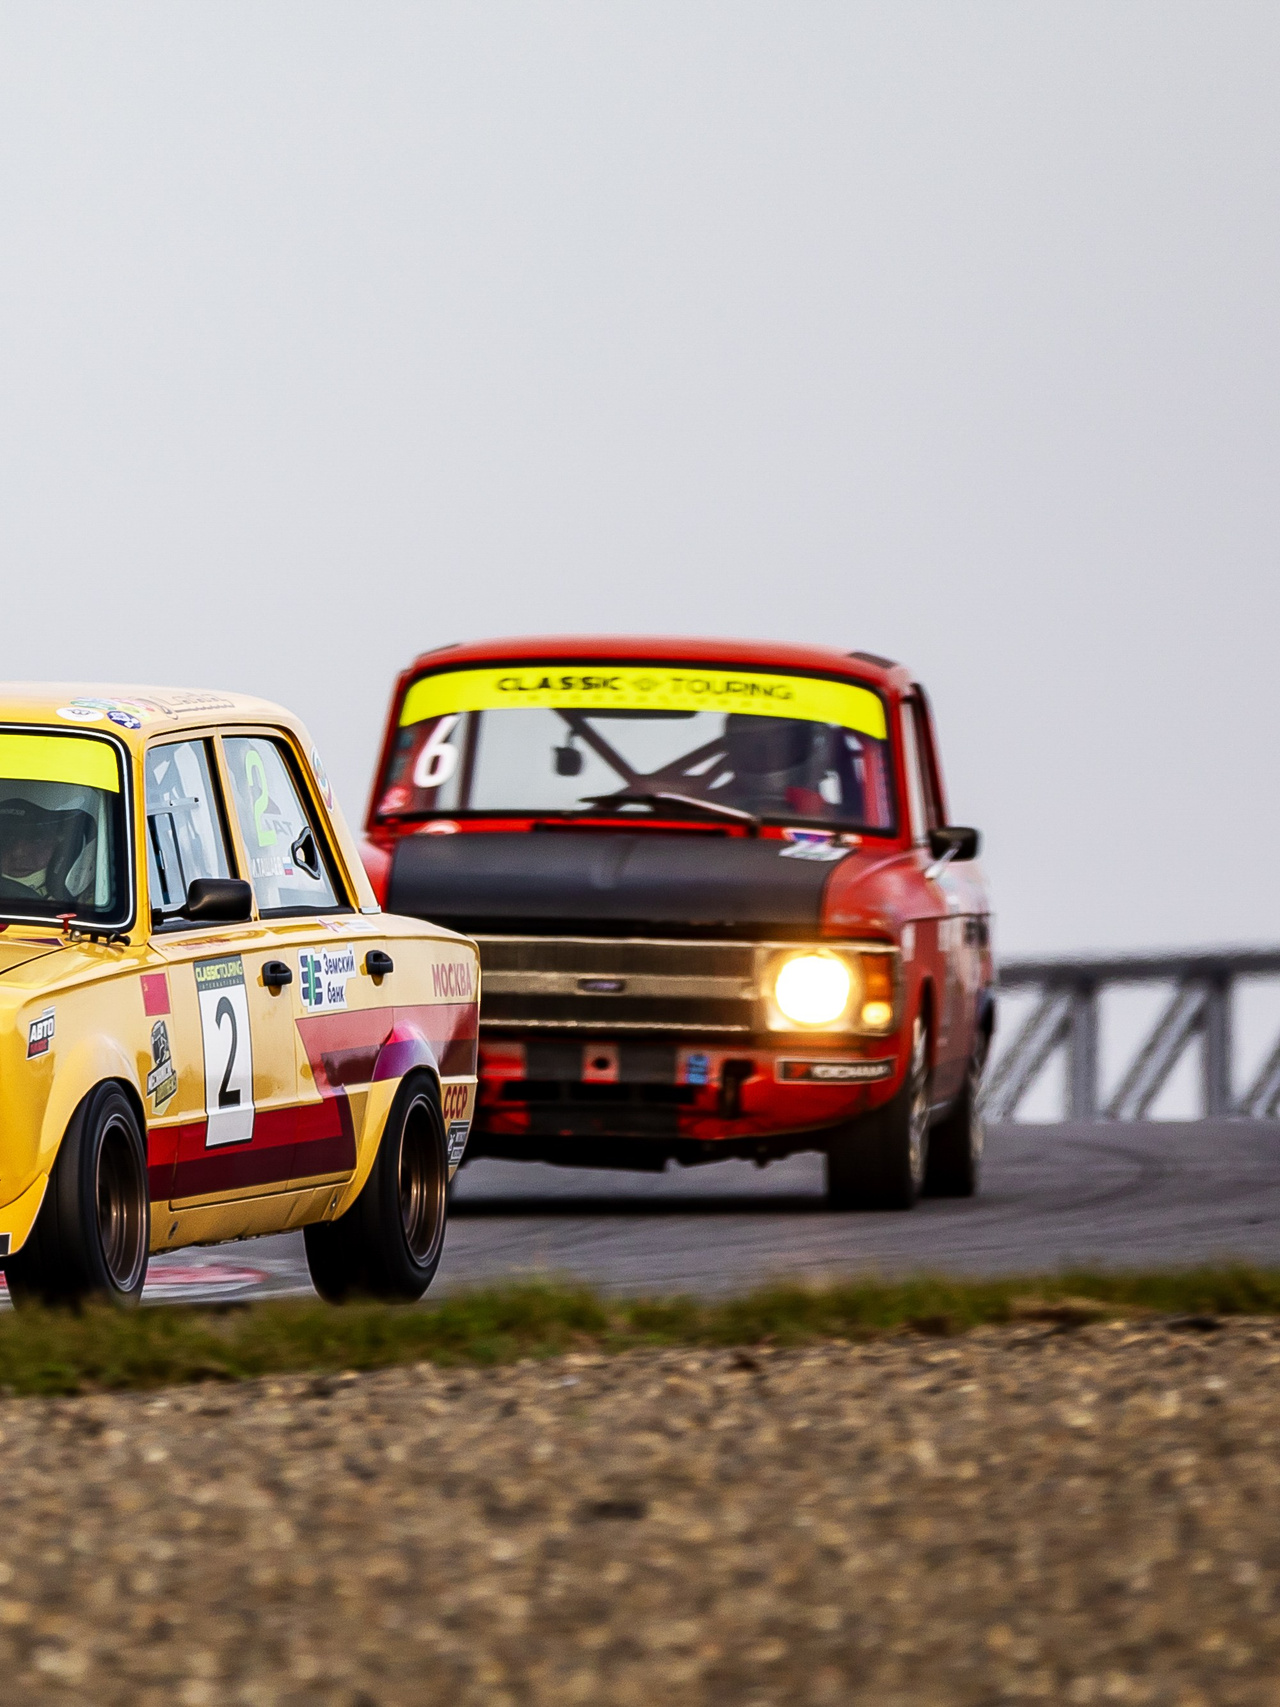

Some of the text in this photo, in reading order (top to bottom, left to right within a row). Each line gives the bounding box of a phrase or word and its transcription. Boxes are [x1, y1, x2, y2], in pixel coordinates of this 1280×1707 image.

[497, 676, 621, 692] CLASSIC
[671, 677, 794, 700] TOURING
[413, 714, 460, 788] 6
[245, 750, 277, 847] 2
[323, 949, 355, 975] Земский
[327, 981, 345, 1004] банк
[431, 962, 473, 998] МОСКВА
[29, 1018, 54, 1043] АВТО
[215, 996, 241, 1109] 2
[444, 1085, 468, 1119] СССР
